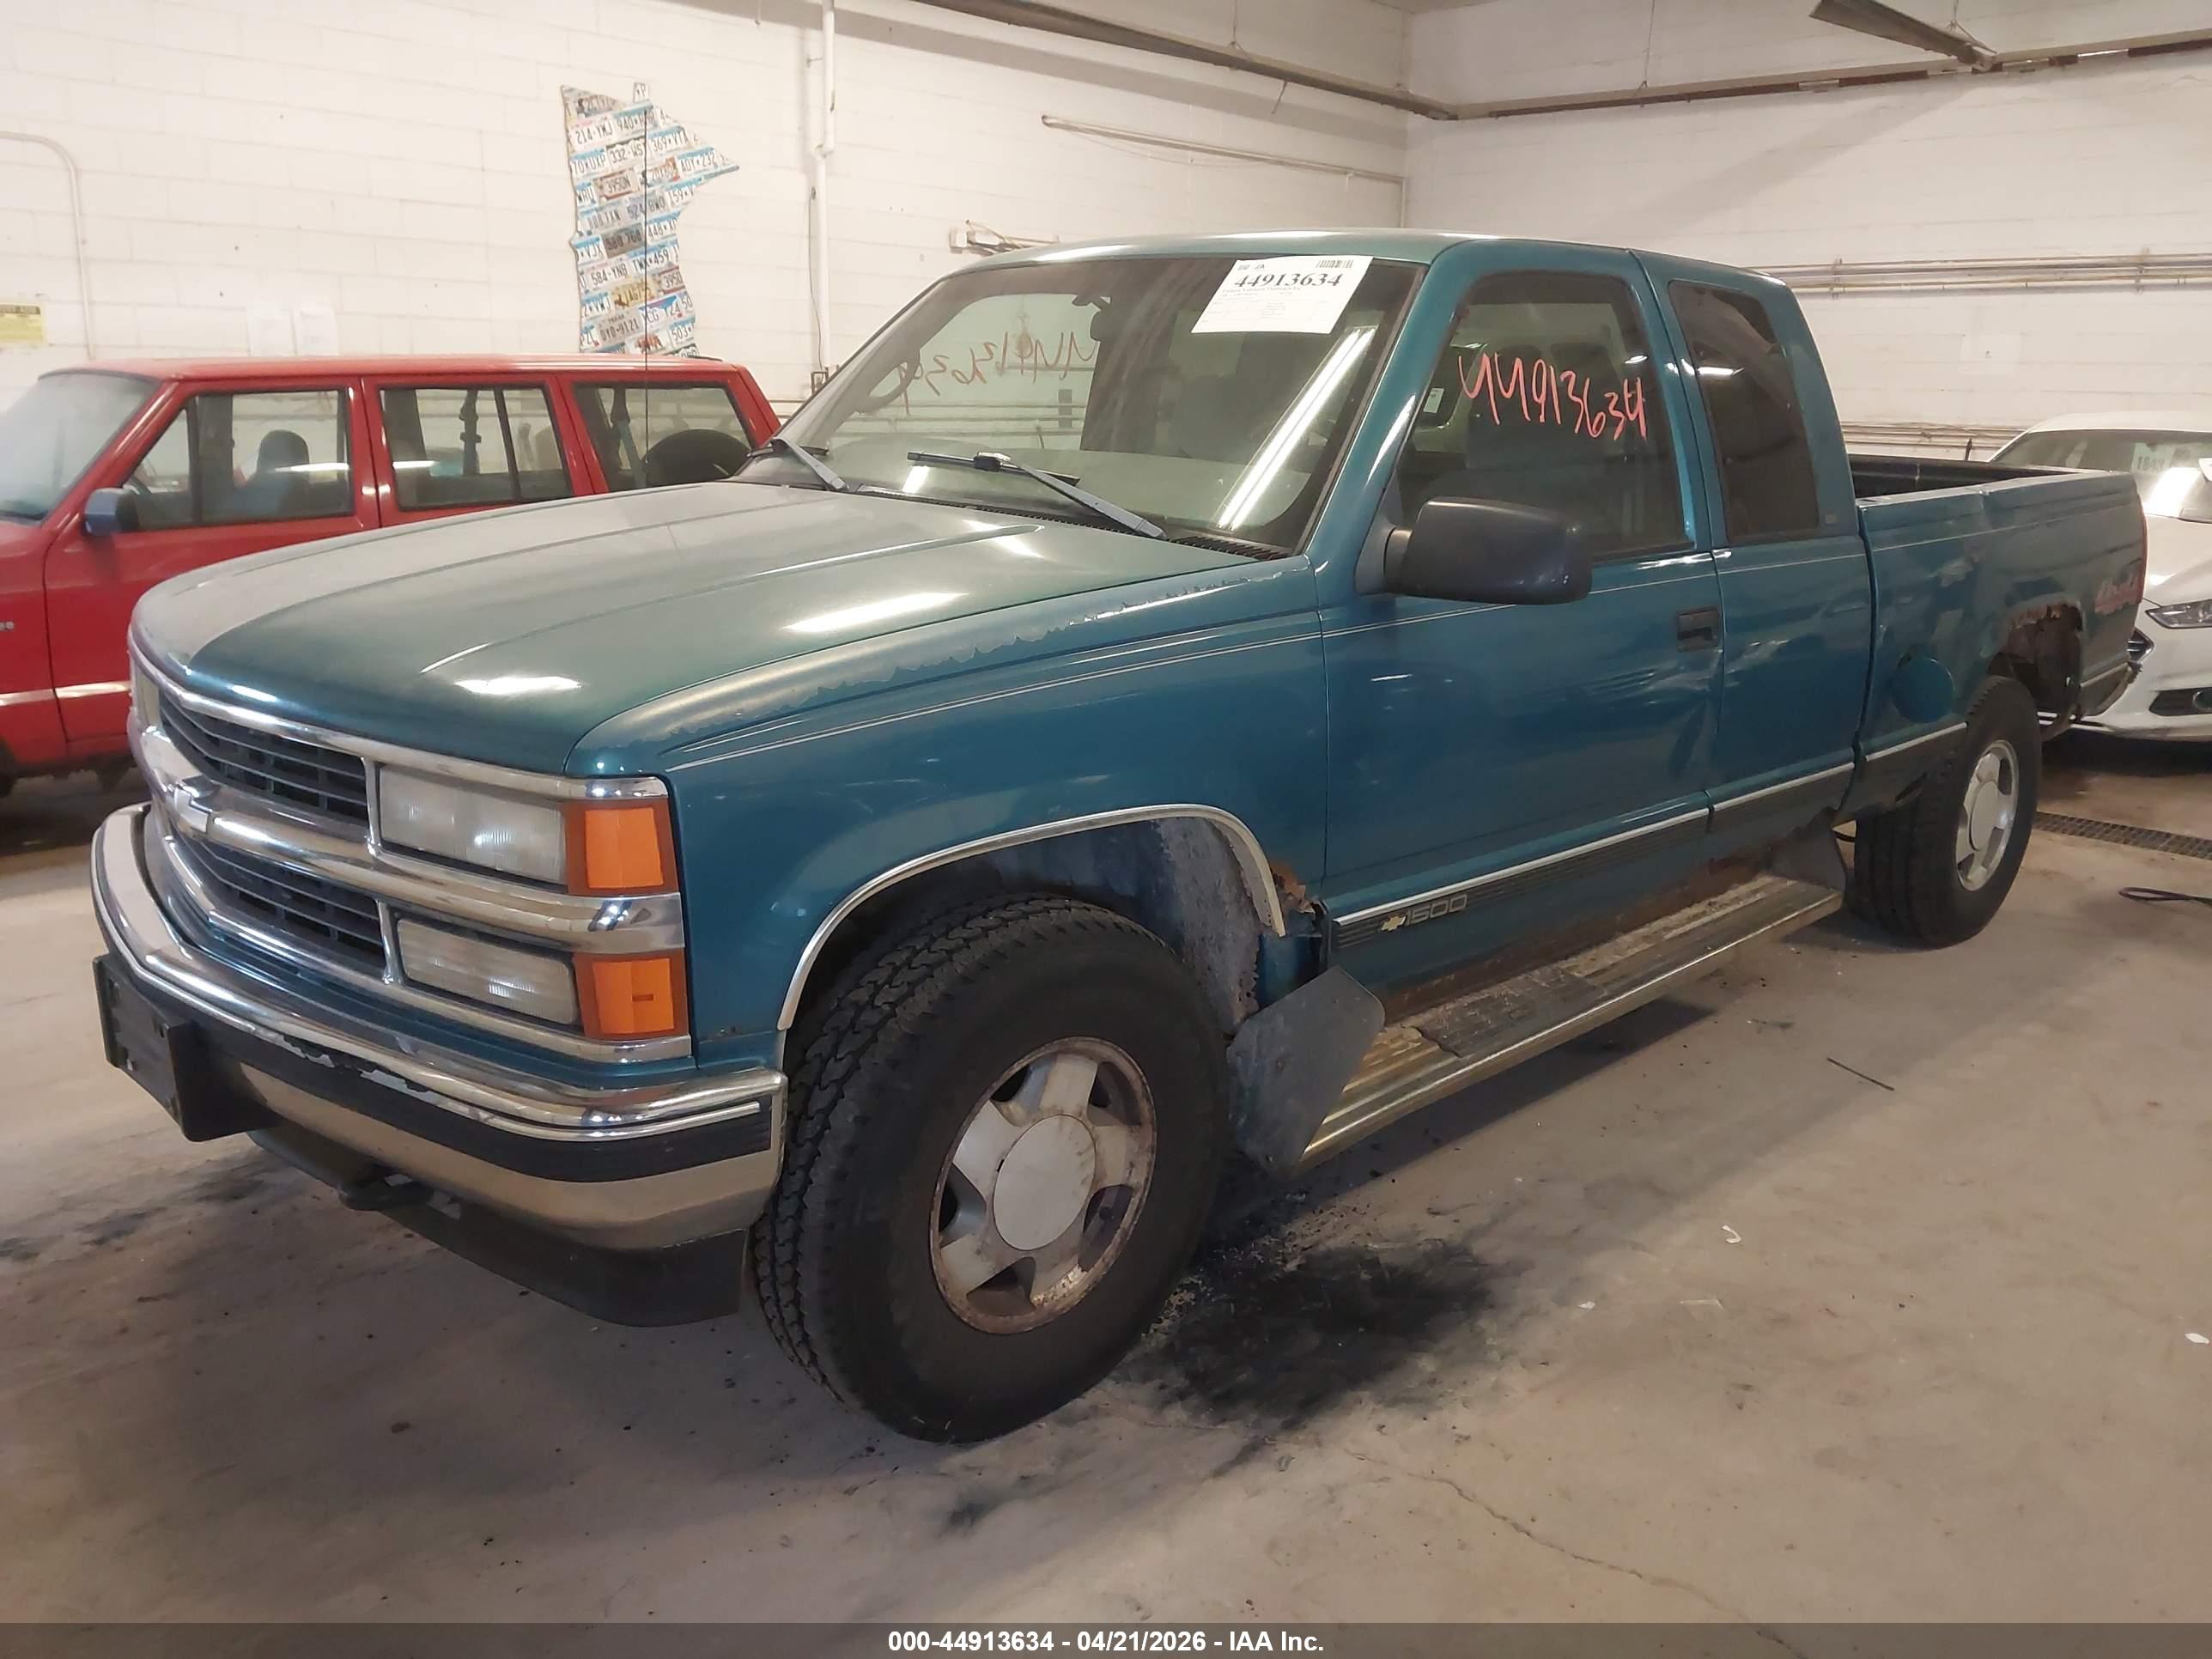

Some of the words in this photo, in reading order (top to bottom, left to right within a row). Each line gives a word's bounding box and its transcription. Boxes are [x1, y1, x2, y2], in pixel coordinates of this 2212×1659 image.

[1234, 272, 1344, 288] 44913634
[1457, 352, 1648, 441] 44913634
[1404, 894, 1469, 927] 1500
